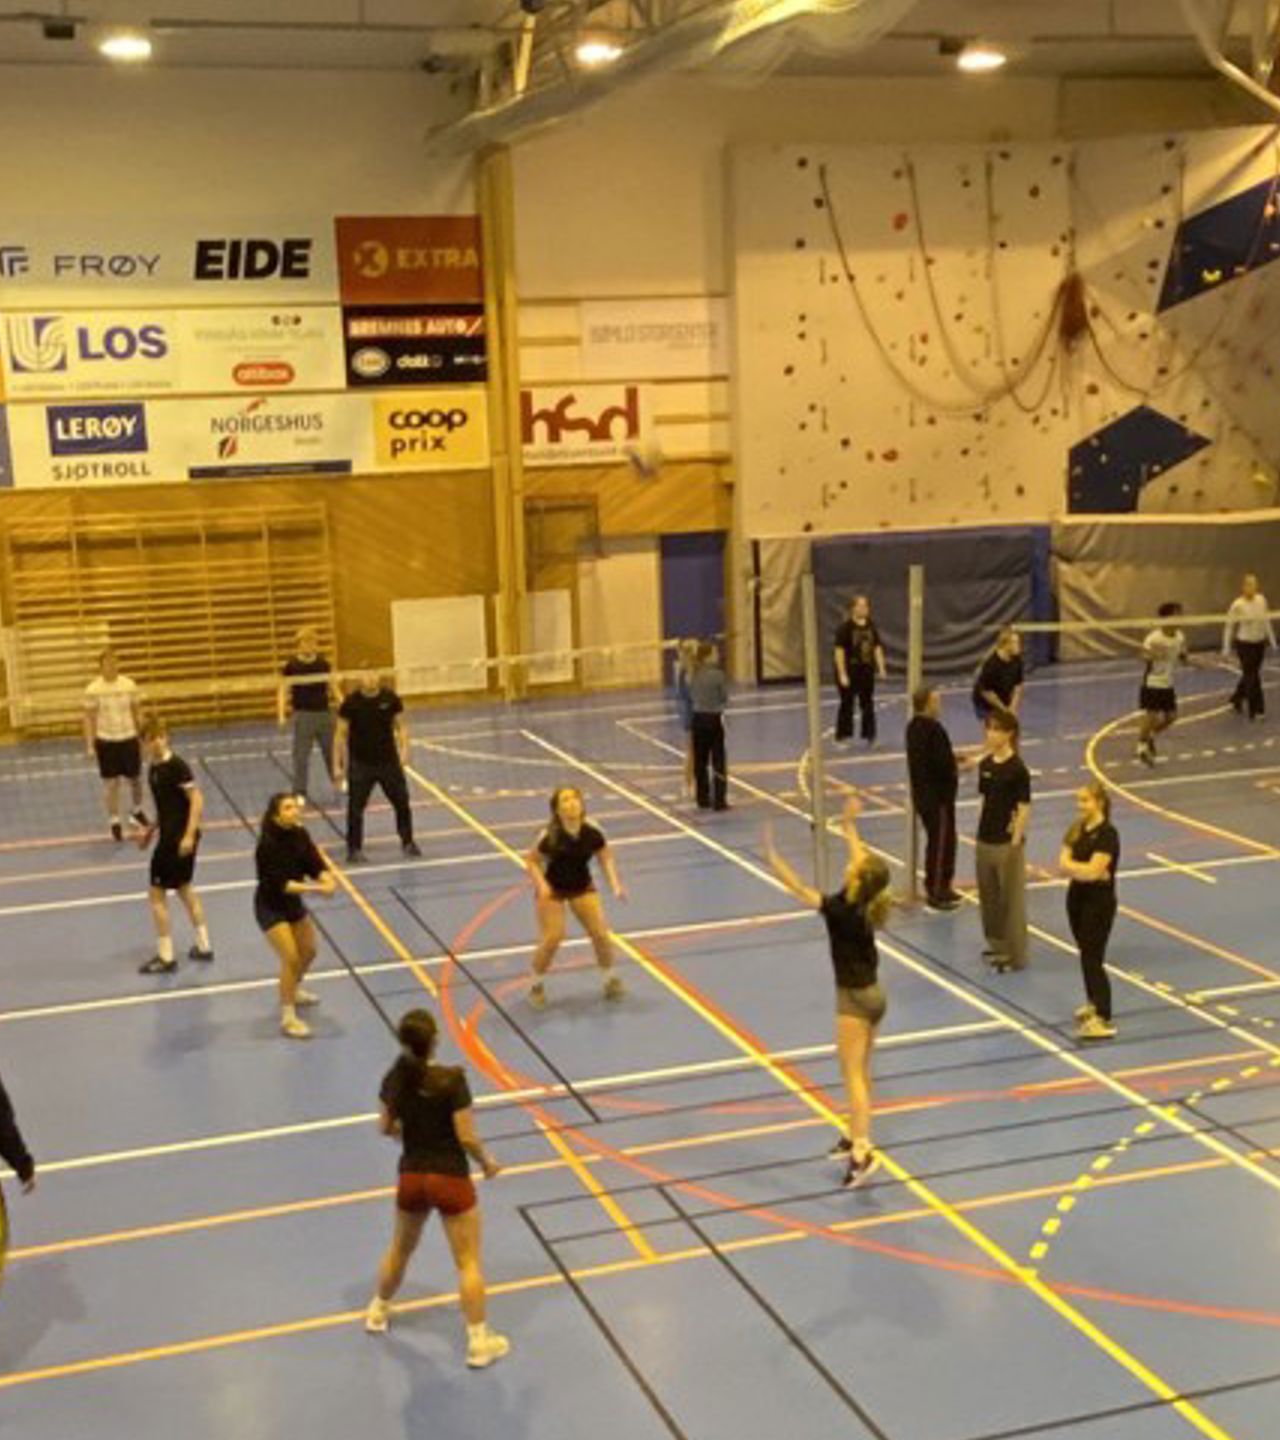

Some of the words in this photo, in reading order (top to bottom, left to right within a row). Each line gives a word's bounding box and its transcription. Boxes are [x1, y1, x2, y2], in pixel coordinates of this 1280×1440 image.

[53, 254, 161, 277] FRØY
[194, 238, 313, 281] EIDE
[397, 247, 480, 269] EXTRA
[77, 325, 168, 361] LOS
[56, 415, 137, 440] LERØY
[210, 413, 324, 434] NORGESHUS
[389, 408, 467, 432] coop
[390, 431, 447, 457] prix
[52, 462, 151, 480] SJØTROLL
